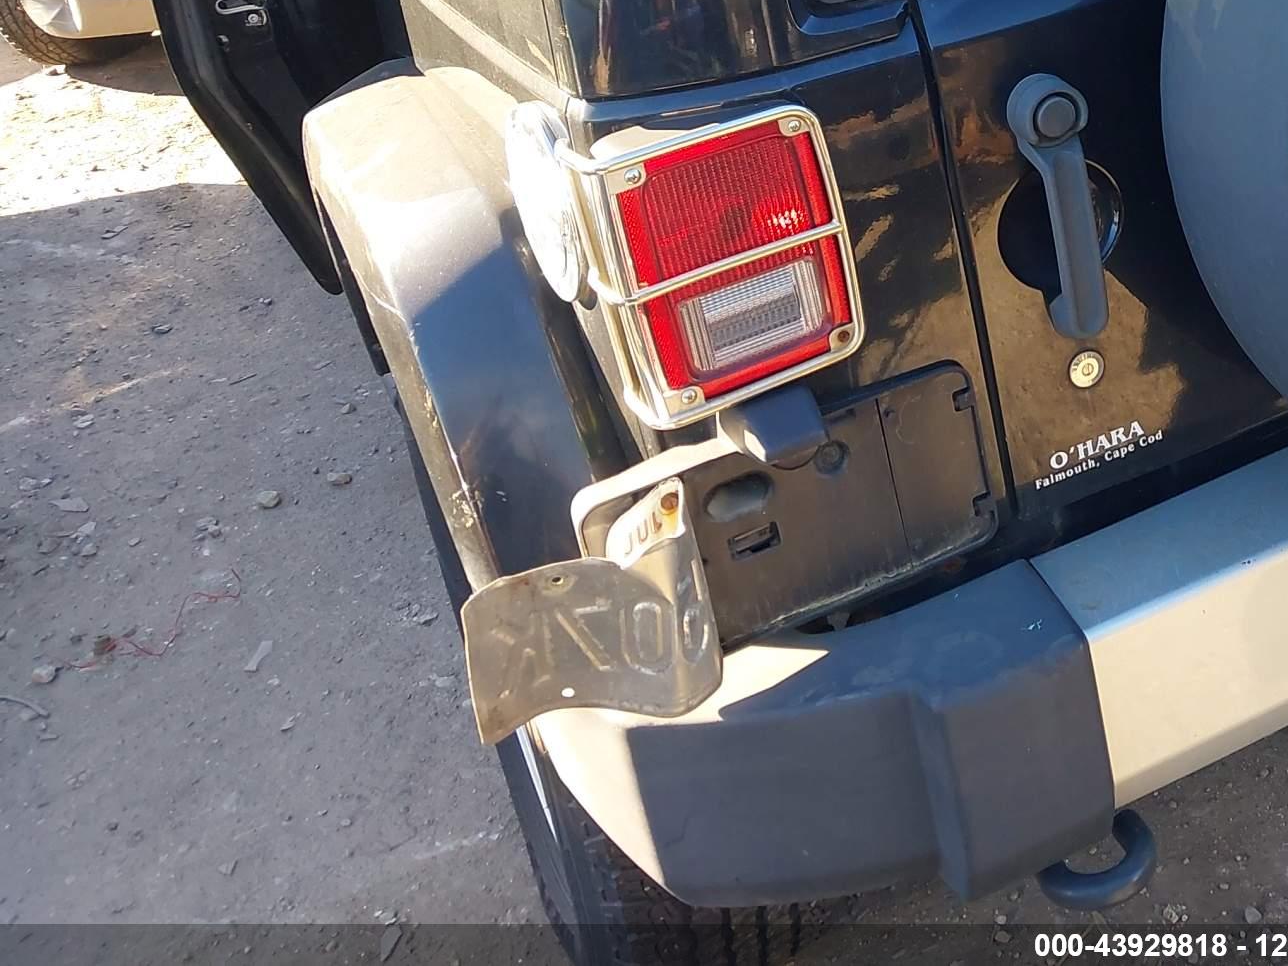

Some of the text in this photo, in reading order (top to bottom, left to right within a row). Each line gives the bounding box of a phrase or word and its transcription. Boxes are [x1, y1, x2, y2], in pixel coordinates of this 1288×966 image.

[1034, 429, 1163, 490] Falmouth, Cape Cod
[1049, 420, 1145, 470] O'HARA
